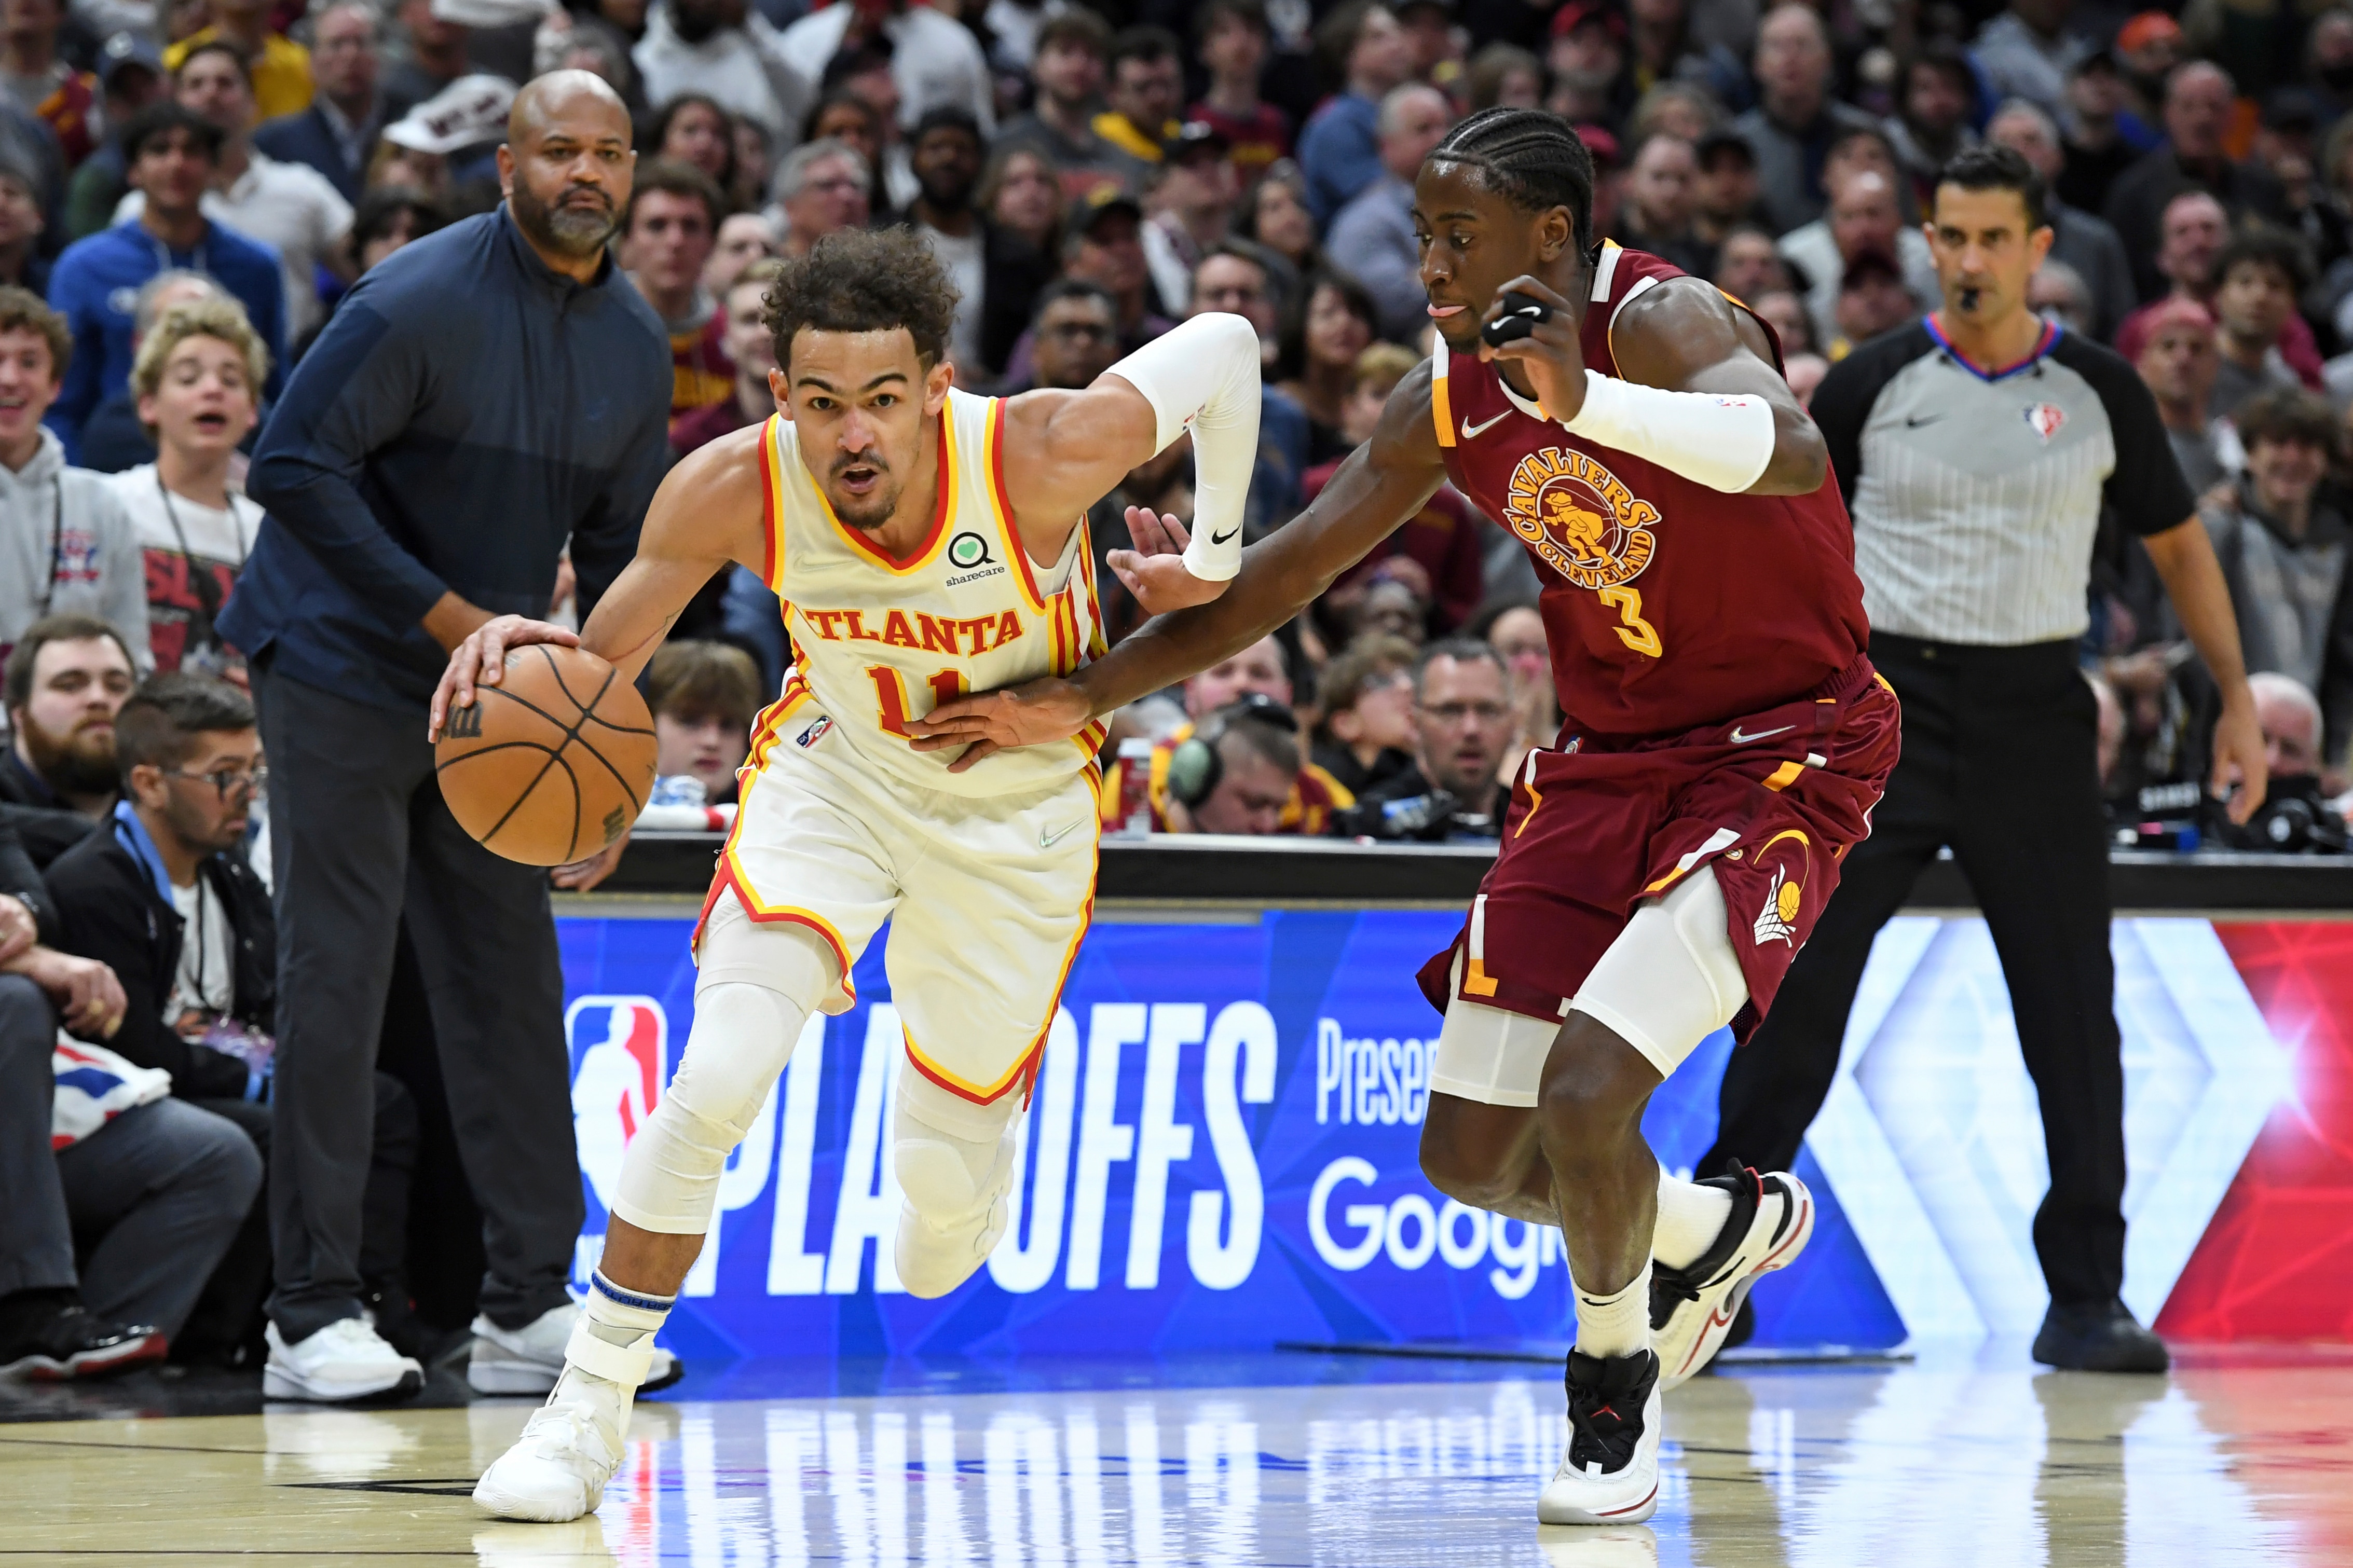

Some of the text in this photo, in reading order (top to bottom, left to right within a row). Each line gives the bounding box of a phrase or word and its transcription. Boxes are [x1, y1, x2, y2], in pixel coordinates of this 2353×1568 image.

[1505, 448, 1660, 542] CAVALIERS
[946, 566, 1005, 587] sharecare
[1537, 530, 1656, 588] CLEVELAND
[800, 608, 1025, 658] TLANTA
[1597, 585, 1662, 657] 3
[685, 1000, 1279, 1298] PLAOFFS
[1307, 1156, 1565, 1300] Goog
